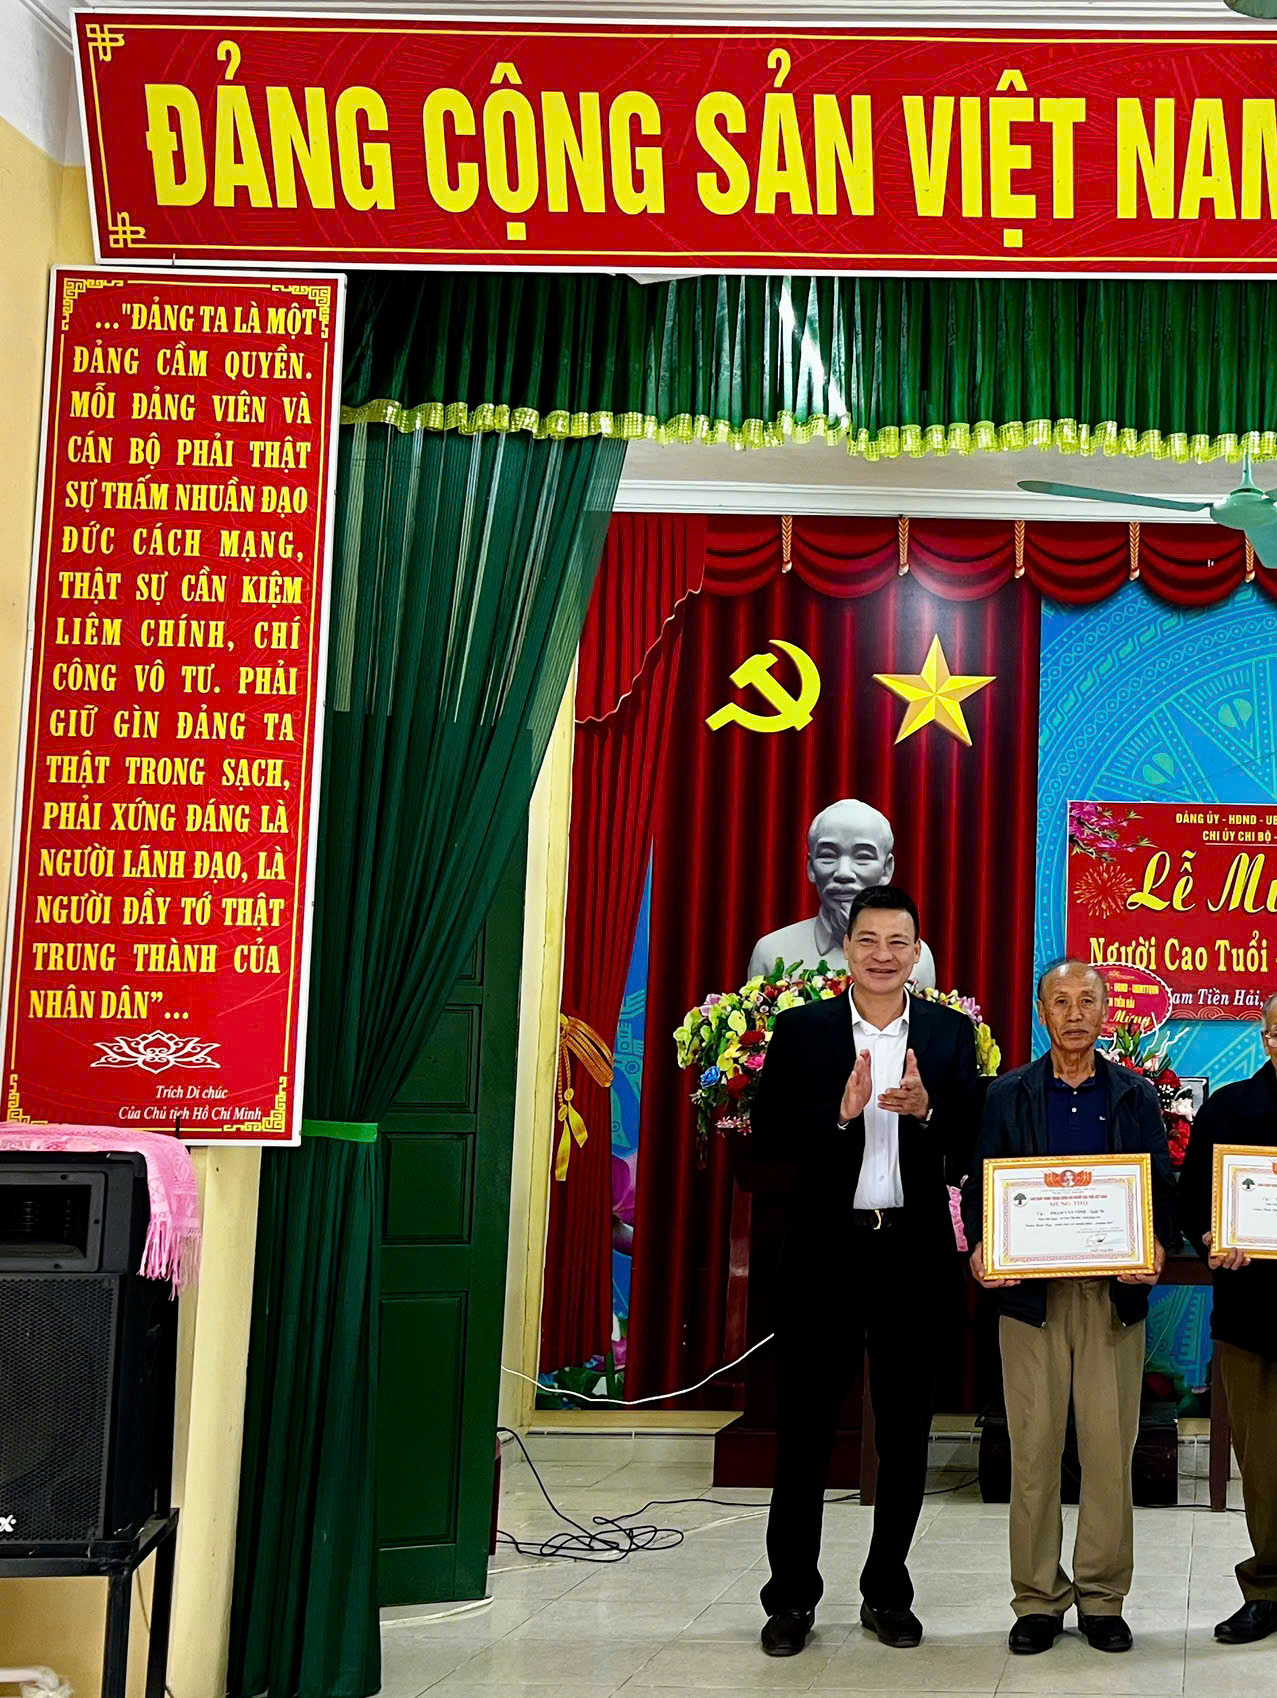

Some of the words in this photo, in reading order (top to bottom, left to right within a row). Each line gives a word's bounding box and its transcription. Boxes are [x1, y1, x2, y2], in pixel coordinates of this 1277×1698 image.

[145, 40, 395, 211] ĐẢNG
[423, 62, 665, 240] CỘNG
[696, 48, 874, 216] SẢN
[902, 70, 1086, 247] VIỆT
[200, 306, 228, 332] TA
[233, 301, 261, 333] LÀ
[266, 303, 316, 339] MỘT
[73, 340, 139, 374] ĐẢNG
[157, 341, 208, 376] CẦM
[225, 344, 312, 380] QUYỀN.
[70, 383, 115, 418] MỖI
[132, 386, 195, 421] ĐẢNG
[212, 390, 266, 422] VIÊN
[282, 392, 312, 424] VÀ
[68, 431, 112, 463] CÁN
[129, 432, 160, 469] BỘ
[176, 432, 234, 466] PHẢI
[250, 436, 311, 473] THẬT
[65, 479, 98, 512] SỰ
[102, 474, 169, 510] THẤM
[175, 477, 255, 512] NHUẦN
[261, 486, 307, 518] ĐẠO
[62, 521, 114, 554] ĐỨC
[133, 523, 201, 556] CÁCH
[219, 530, 303, 562] MẠNG,
[59, 567, 121, 604] THẬT
[136, 571, 168, 605] SỰ
[182, 566, 226, 602] CẦN
[241, 570, 302, 608] KIỆM
[56, 612, 122, 645] LIÊM
[141, 614, 234, 651] CHÍNH,
[255, 616, 300, 649] CHÍ
[53, 658, 117, 691] CÔNG
[135, 659, 164, 692] VÔ
[182, 664, 220, 693] TƯ.
[238, 660, 297, 695] PHẢI
[50, 705, 98, 737] GIỮ
[114, 705, 159, 738] GÌN
[176, 704, 245, 740] ĐẢNG
[264, 713, 294, 741] TA
[46, 750, 110, 788] THẬT
[126, 757, 205, 785] TRONG
[222, 759, 290, 791] SẠCH,
[42, 795, 102, 830] PHẢI
[110, 797, 176, 831] XỨNG
[186, 799, 250, 832] ĐÁNG
[260, 800, 288, 833] LÀ
[1202, 831, 1220, 841] CHI
[1238, 832, 1255, 842] CHI
[39, 843, 115, 877] NGƯỜI
[123, 845, 186, 878] LÃNH
[193, 851, 248, 883] ĐẠO,
[257, 846, 286, 880] LÀ
[1126, 850, 1197, 912] Lễ
[36, 890, 112, 924] NGƯỜI
[122, 888, 171, 924] ĐẦY
[181, 891, 212, 925] TỚ
[222, 892, 284, 931] THẬT
[33, 943, 116, 971] TRUNG
[133, 938, 217, 972] THÀNH
[234, 938, 280, 973] CỦA
[1164, 938, 1208, 971] Cao
[1215, 930, 1268, 973] Tuổi
[29, 984, 95, 1018] NHÂN
[1197, 988, 1229, 1005] Tiền
[1233, 989, 1264, 1009] Hải,
[119, 1106, 141, 1120] Của
[192, 1104, 209, 1120] Hồ
[211, 1106, 231, 1120] Chí
[233, 1107, 262, 1120] Minh
[155, 1085, 184, 1099] Trích
[186, 1086, 200, 1099] Di
[202, 1086, 229, 1099] chúc
